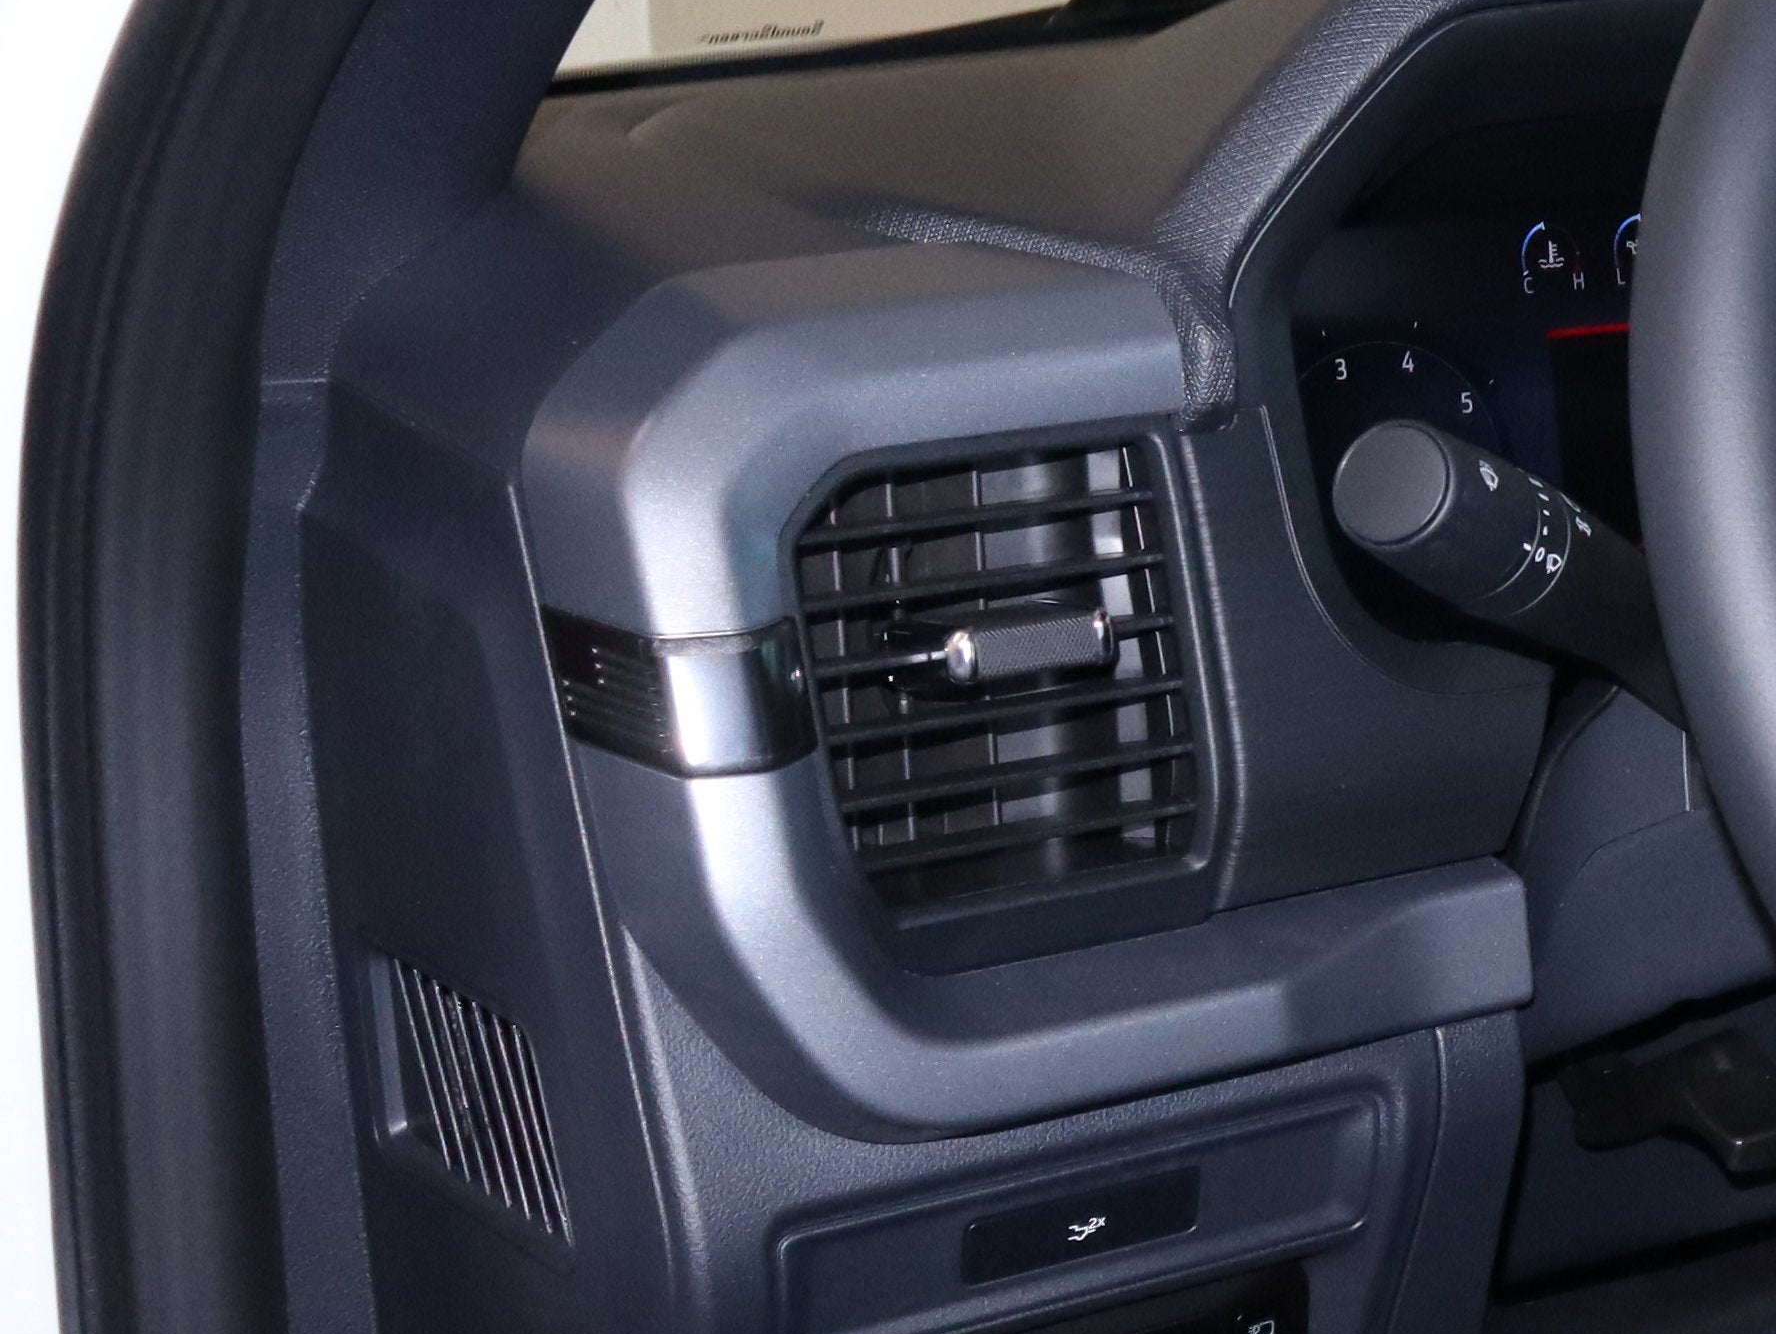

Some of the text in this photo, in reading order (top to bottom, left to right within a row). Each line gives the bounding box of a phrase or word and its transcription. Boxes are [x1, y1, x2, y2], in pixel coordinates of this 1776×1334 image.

[1523, 276, 1534, 294] C
[1572, 271, 1585, 290] H
[1616, 268, 1626, 285] L
[1334, 358, 1348, 381] 3
[1401, 350, 1415, 373] 4
[1460, 392, 1474, 413] 5
